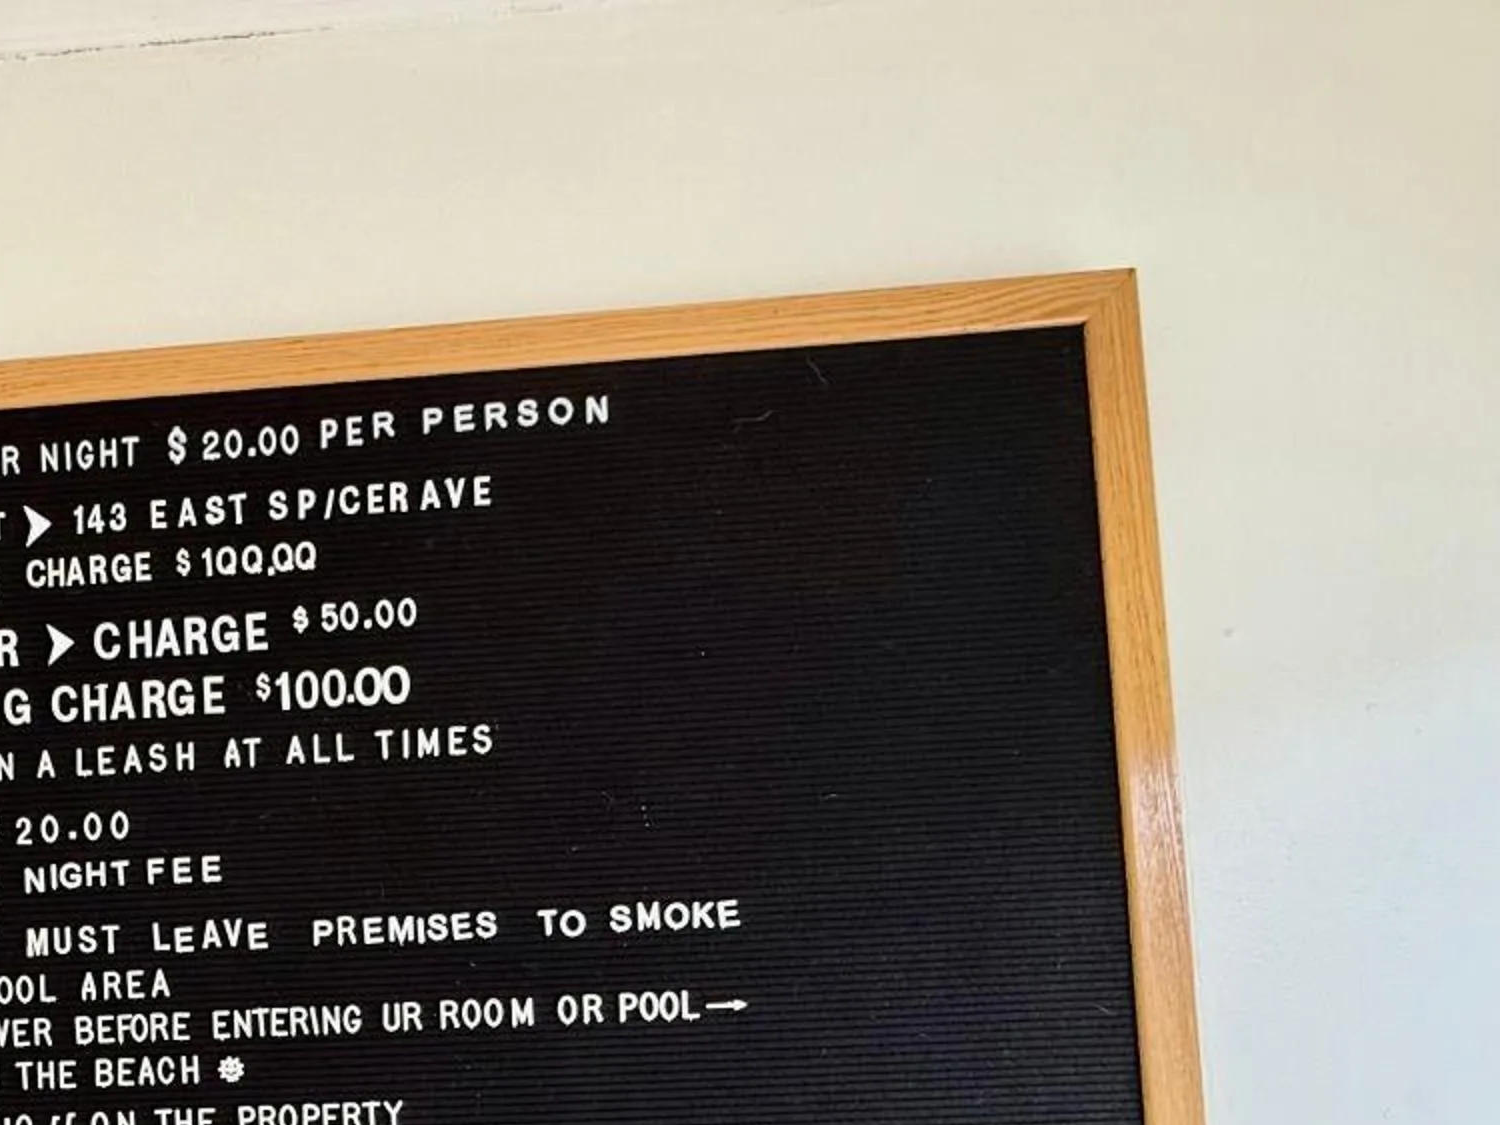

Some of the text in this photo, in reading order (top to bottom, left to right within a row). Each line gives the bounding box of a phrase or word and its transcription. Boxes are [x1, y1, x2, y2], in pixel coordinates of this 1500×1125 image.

[40, 435, 140, 473] NIGHT
[320, 411, 395, 449] PER
[422, 395, 609, 435] PERSON
[73, 502, 127, 535] 143
[150, 492, 248, 529] EAST
[26, 551, 153, 589] CHARGE
[93, 611, 269, 660] CHARGE
[51, 675, 226, 723] CHARGE
[23, 859, 130, 895] NIGHT
[146, 855, 223, 885] FEE
[26, 924, 120, 958] MUST
[152, 918, 269, 954] LEAVE
[312, 911, 498, 947] PREMISES
[536, 908, 587, 938] TO
[609, 899, 741, 934] SMOKE
[14, 1059, 77, 1091] THE
[95, 1054, 200, 1089] BEACH
